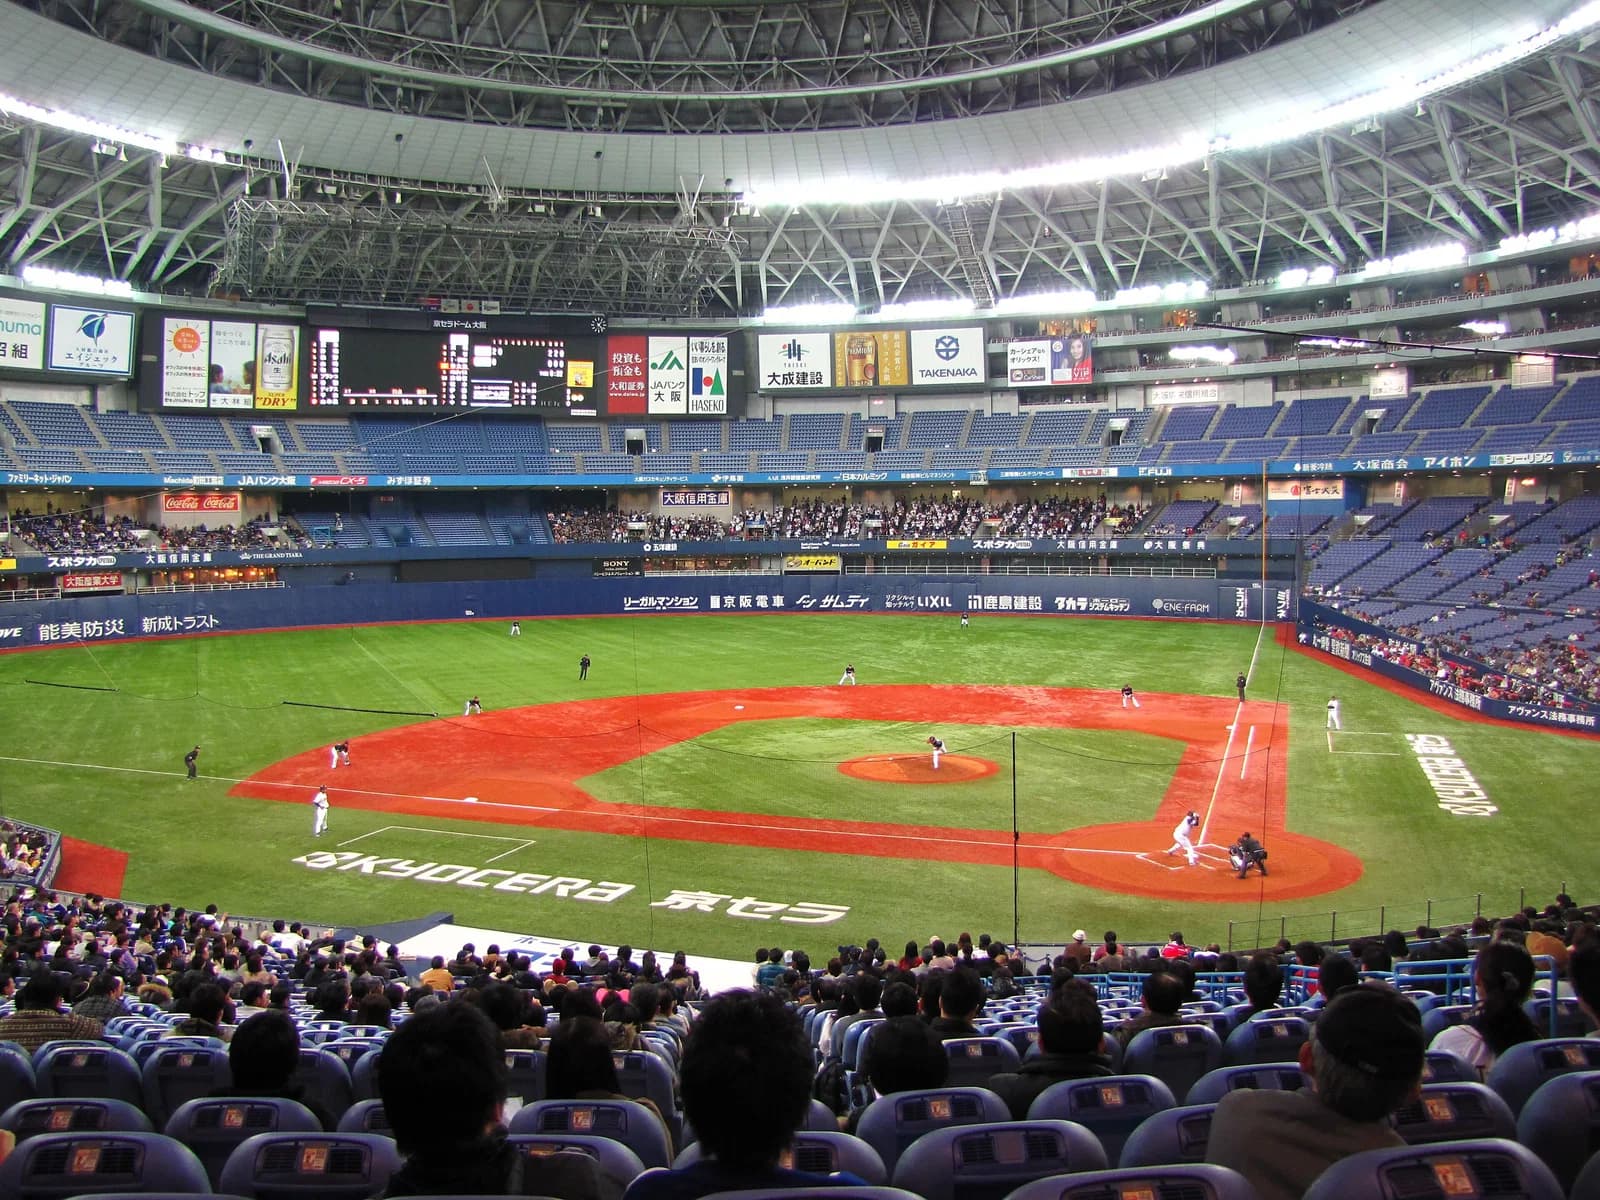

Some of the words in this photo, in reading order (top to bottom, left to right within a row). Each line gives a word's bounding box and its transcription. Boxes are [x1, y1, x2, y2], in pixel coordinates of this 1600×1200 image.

[264, 351, 292, 365] Asahi
[612, 352, 642, 364] 投資も
[613, 365, 642, 377] 預金も
[919, 368, 978, 378] TAKENAKA
[767, 371, 824, 386] 大成建設
[609, 381, 645, 391] 大和証券
[651, 381, 685, 390] JAバンク
[654, 391, 681, 402] 大阪
[691, 400, 724, 412] HASEKO
[1353, 459, 1409, 470] 大塚商会
[1424, 455, 1477, 469] アイホン
[238, 475, 296, 486] JAバンク大阪
[340, 476, 366, 485] CX-5
[387, 476, 432, 486] みずほ証券
[842, 472, 888, 481] 日本カルミック
[663, 493, 729, 505] 大阪信用金庫
[973, 540, 1015, 549] スポタカ
[1056, 540, 1118, 550] 大阪信用金庫
[48, 556, 98, 567] スポタカ
[146, 552, 213, 564] 大阪信用金庫
[803, 558, 836, 567] オーバンド
[66, 575, 119, 587] 大阪産業大学
[624, 596, 698, 607] リーガルマンション
[723, 595, 784, 608] 京阪電車
[819, 594, 870, 608] サムティ
[917, 596, 952, 608] LIXIL
[984, 595, 1042, 610] 鹿島建設
[1055, 597, 1088, 610] タカラ
[1235, 587, 1245, 617] エコリカ
[1163, 602, 1210, 613] ENE-FARM
[40, 618, 125, 641] 能美防災
[142, 614, 219, 633] 新成トラスト
[1507, 705, 1596, 727] アヴァンス法務事務所
[648, 889, 851, 926] 京セラ
